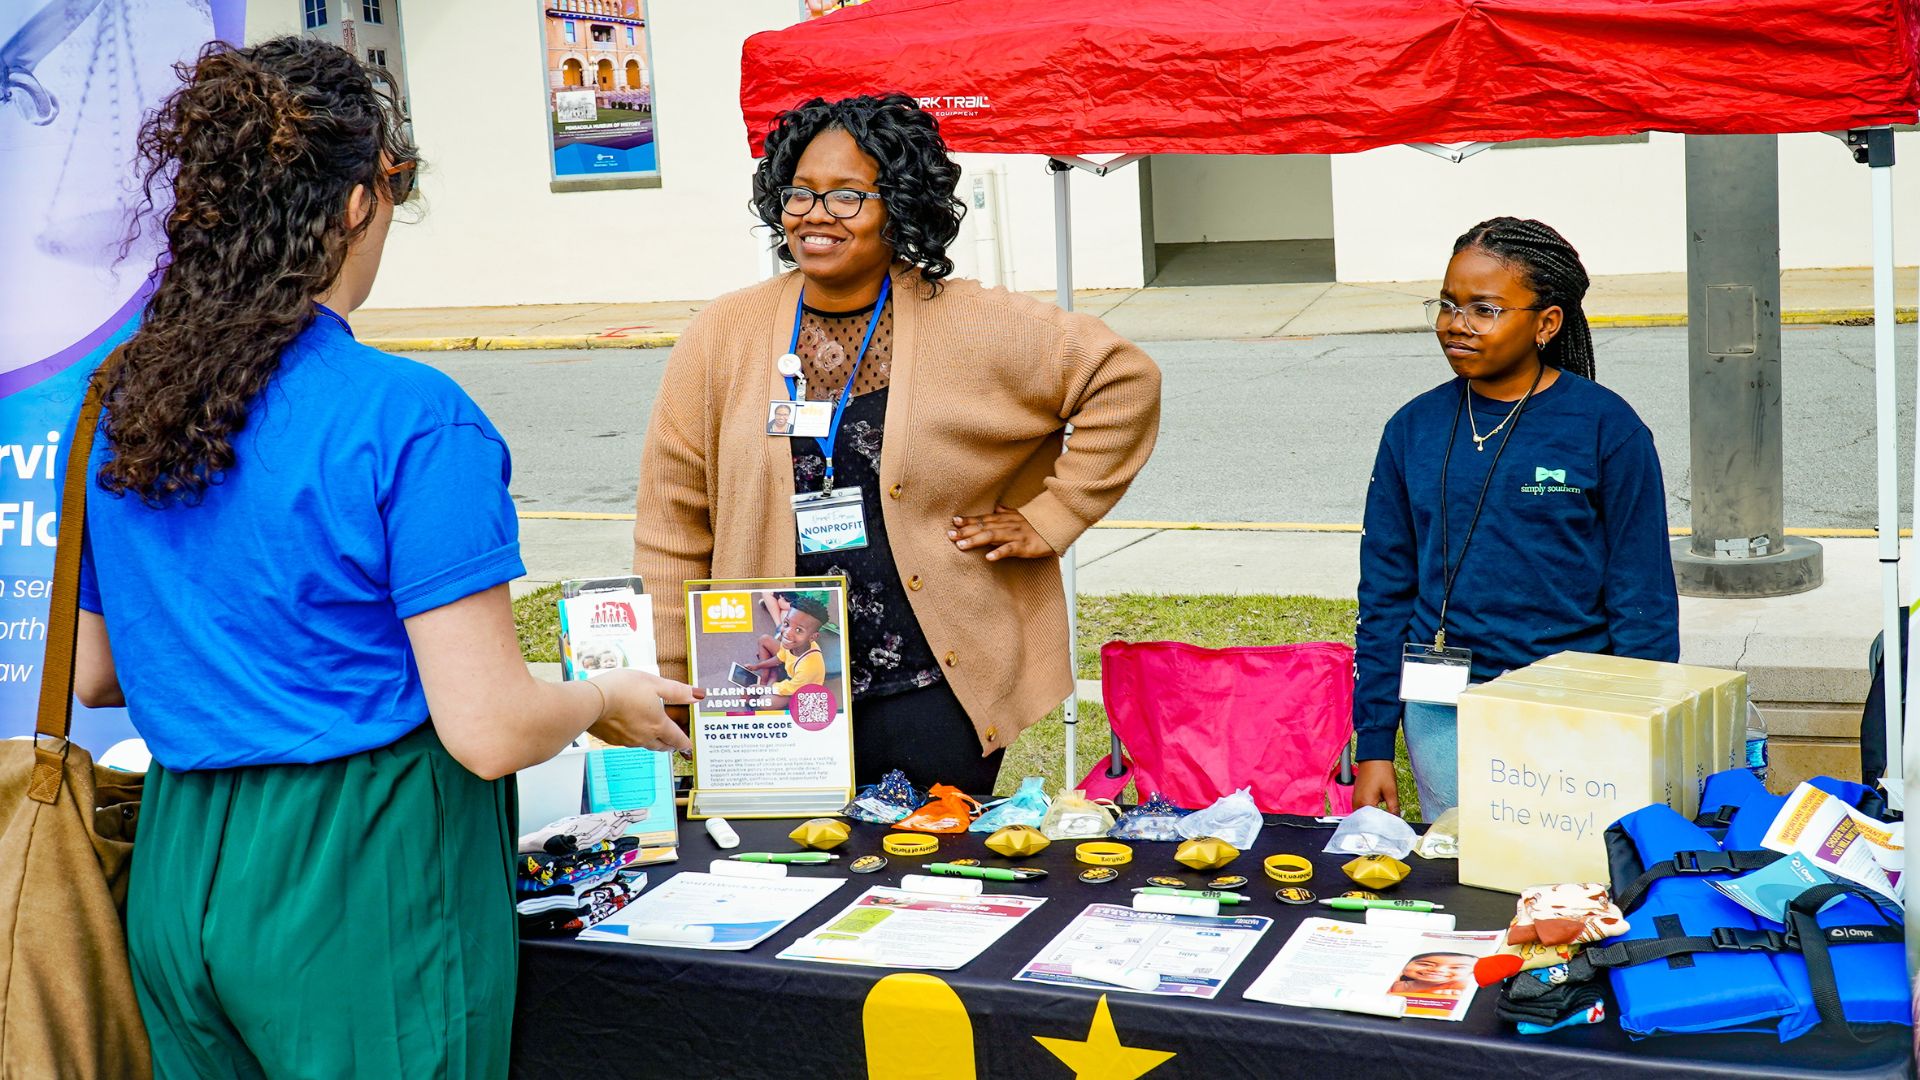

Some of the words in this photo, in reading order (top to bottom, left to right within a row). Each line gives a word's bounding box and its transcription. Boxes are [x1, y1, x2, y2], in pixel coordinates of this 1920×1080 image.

[1521, 483, 1546, 495] simply
[1547, 484, 1581, 494] southern
[805, 521, 863, 535] NONPROFIT
[706, 687, 745, 696] LEARN
[746, 687, 780, 695] MORE
[707, 699, 747, 708] ABOUT
[749, 698, 772, 707] CHS
[1492, 759, 1551, 796] Baby
[1560, 769, 1576, 793] is
[1585, 780, 1616, 800] on
[1491, 799, 1531, 825] the
[1540, 812, 1593, 840] way!
[1801, 868, 1817, 884] Onyx
[1849, 928, 1874, 938] Onyx
